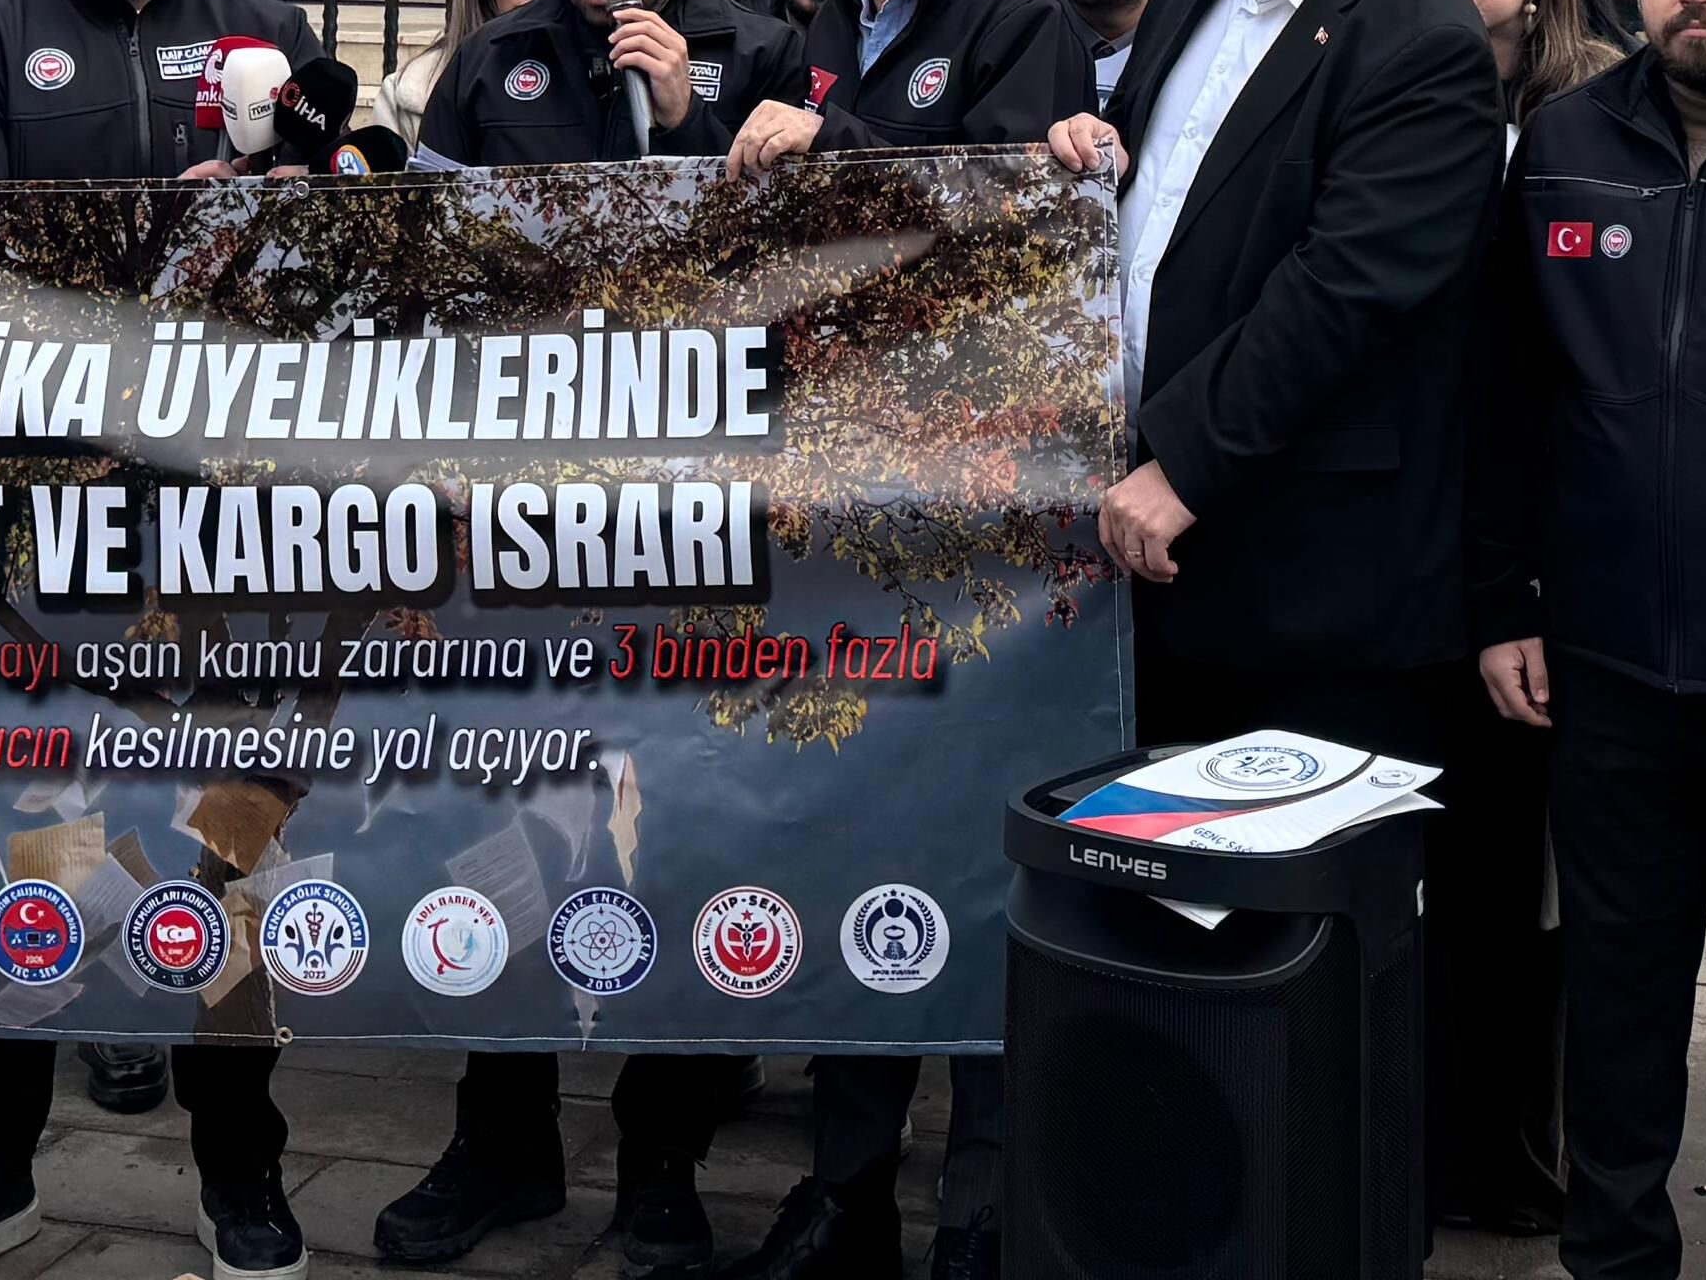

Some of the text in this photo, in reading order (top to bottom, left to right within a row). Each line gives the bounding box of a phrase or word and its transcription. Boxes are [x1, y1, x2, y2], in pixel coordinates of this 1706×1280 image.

[137, 308, 771, 440] ÜYELİKLERİNDE
[29, 485, 130, 595] VE
[159, 483, 440, 594] KARGO
[470, 481, 755, 593] ISRARI
[75, 640, 182, 692] aşan
[197, 630, 322, 679] kamu
[337, 637, 526, 679] zararına
[544, 637, 594, 679] ve
[609, 625, 636, 680] 3
[651, 624, 809, 680] binden
[824, 623, 939, 681] fazla
[84, 712, 354, 771] kesilmesine
[364, 713, 437, 787] yol
[447, 726, 600, 787] açıyor.
[1069, 843, 1168, 881] LENYES
[131, 937, 158, 975] DEVLET
